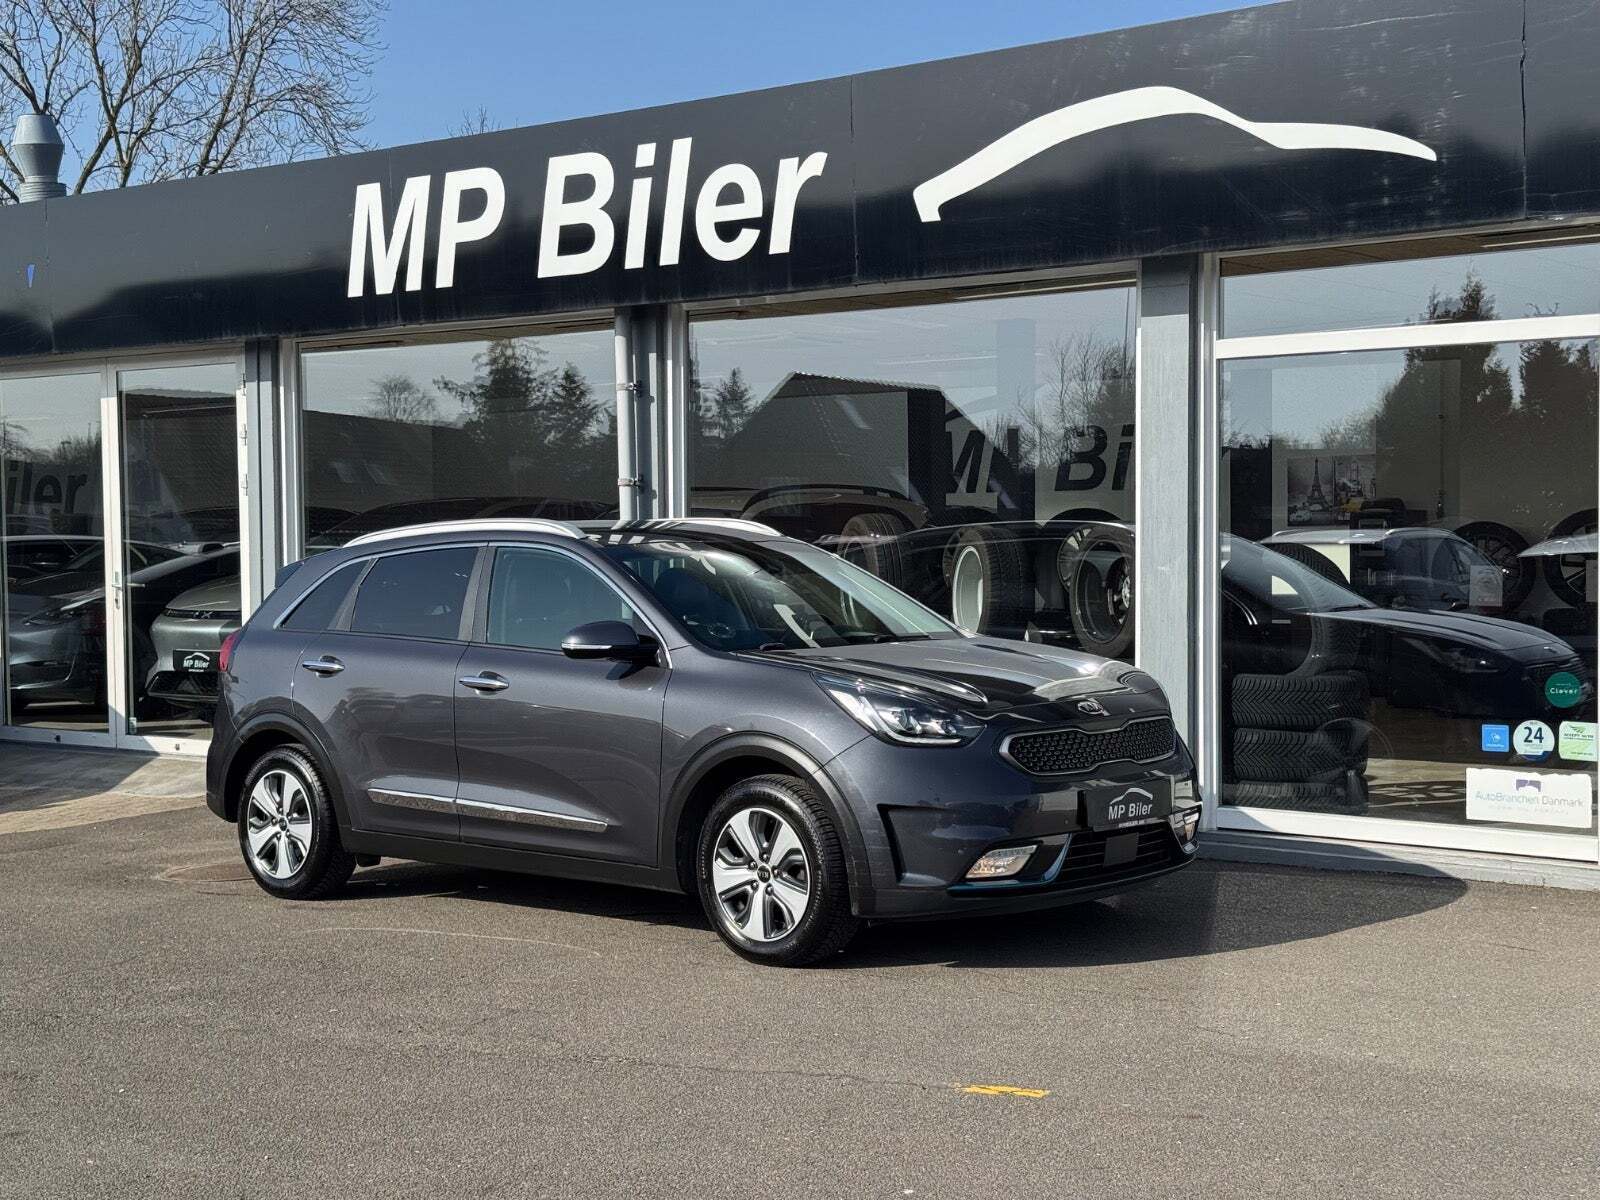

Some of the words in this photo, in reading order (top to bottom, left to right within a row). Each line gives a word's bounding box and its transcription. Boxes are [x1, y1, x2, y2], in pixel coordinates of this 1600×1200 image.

[347, 166, 506, 298] MP
[537, 137, 829, 279] Biler
[183, 659, 194, 668] MP
[1523, 726, 1545, 744] 24
[1475, 790, 1539, 805] AutoBranchen
[1541, 795, 1584, 808] Danmark
[1108, 804, 1126, 820] MP
[1128, 801, 1153, 817] Biler
